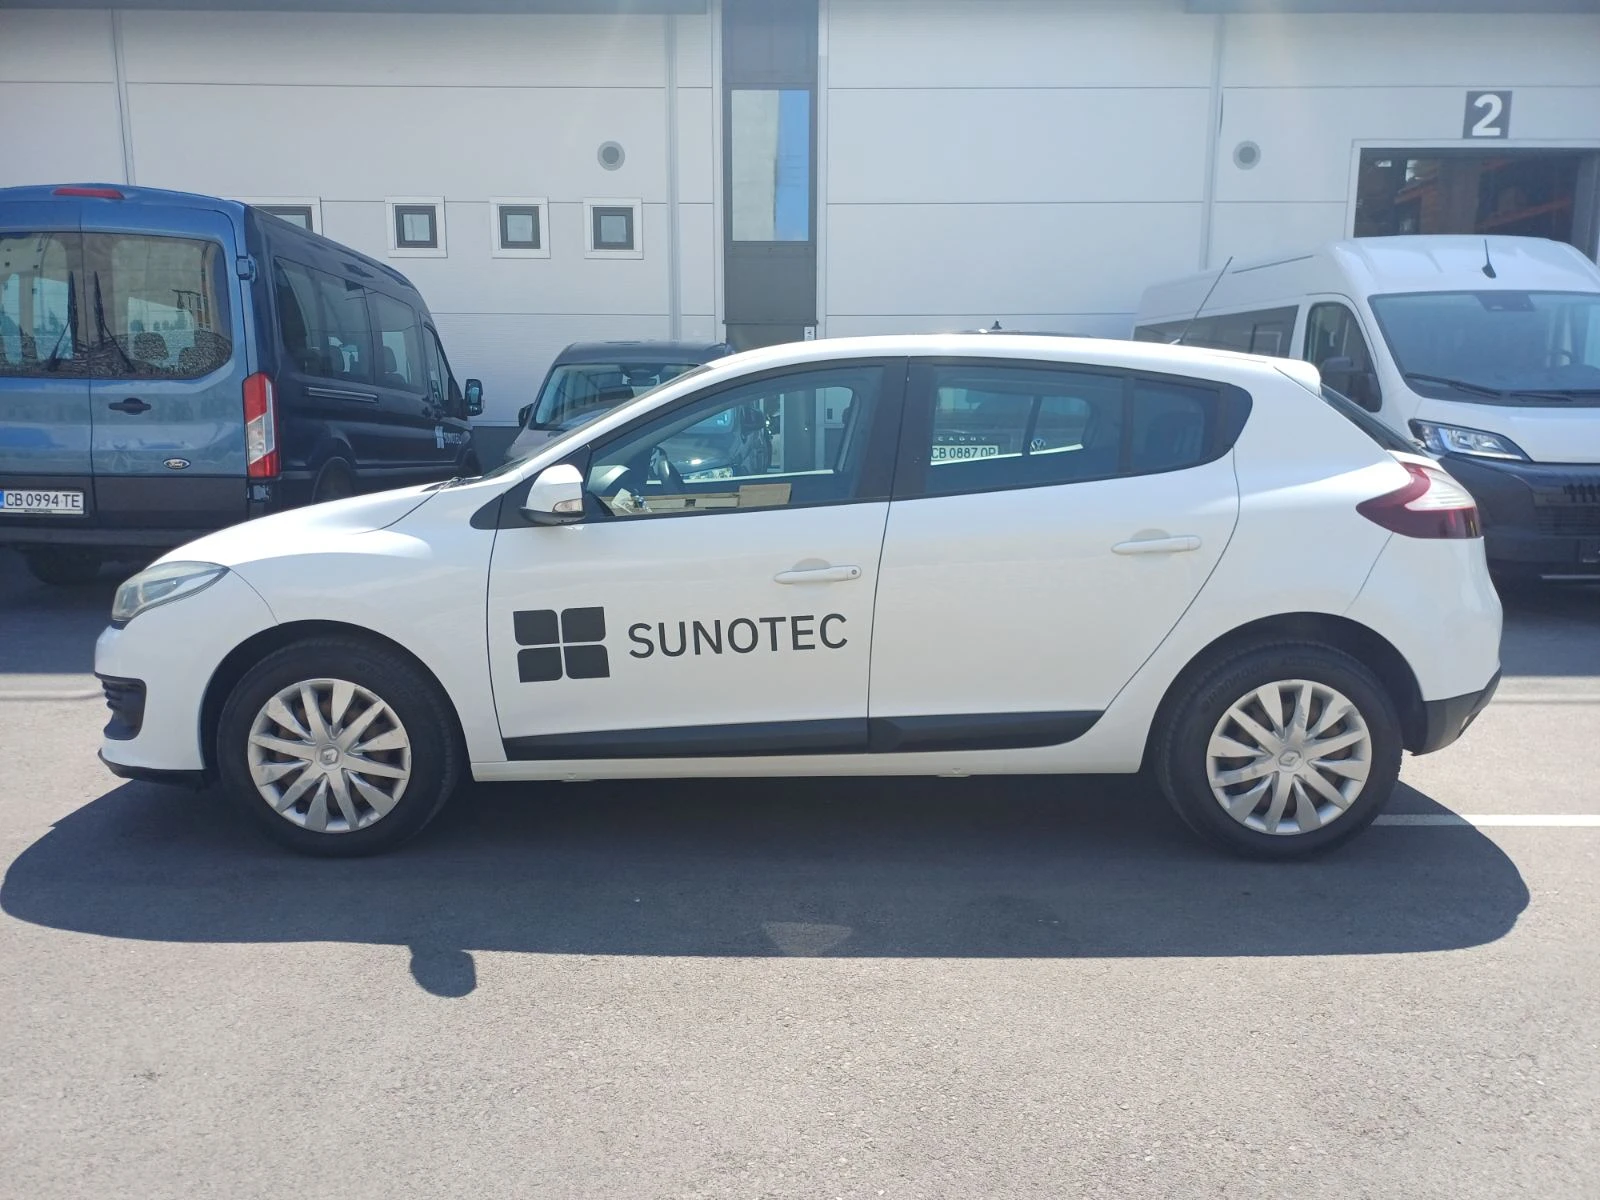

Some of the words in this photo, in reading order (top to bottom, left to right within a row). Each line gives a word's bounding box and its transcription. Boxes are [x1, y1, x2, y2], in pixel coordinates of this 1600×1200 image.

[1472, 94, 1502, 136] 2
[932, 447, 946, 459] CB
[949, 447, 978, 459] 0887
[6, 493, 23, 506] CB
[26, 493, 59, 507] 0994
[62, 494, 80, 508] TE
[628, 613, 847, 659] SUNOTEC
